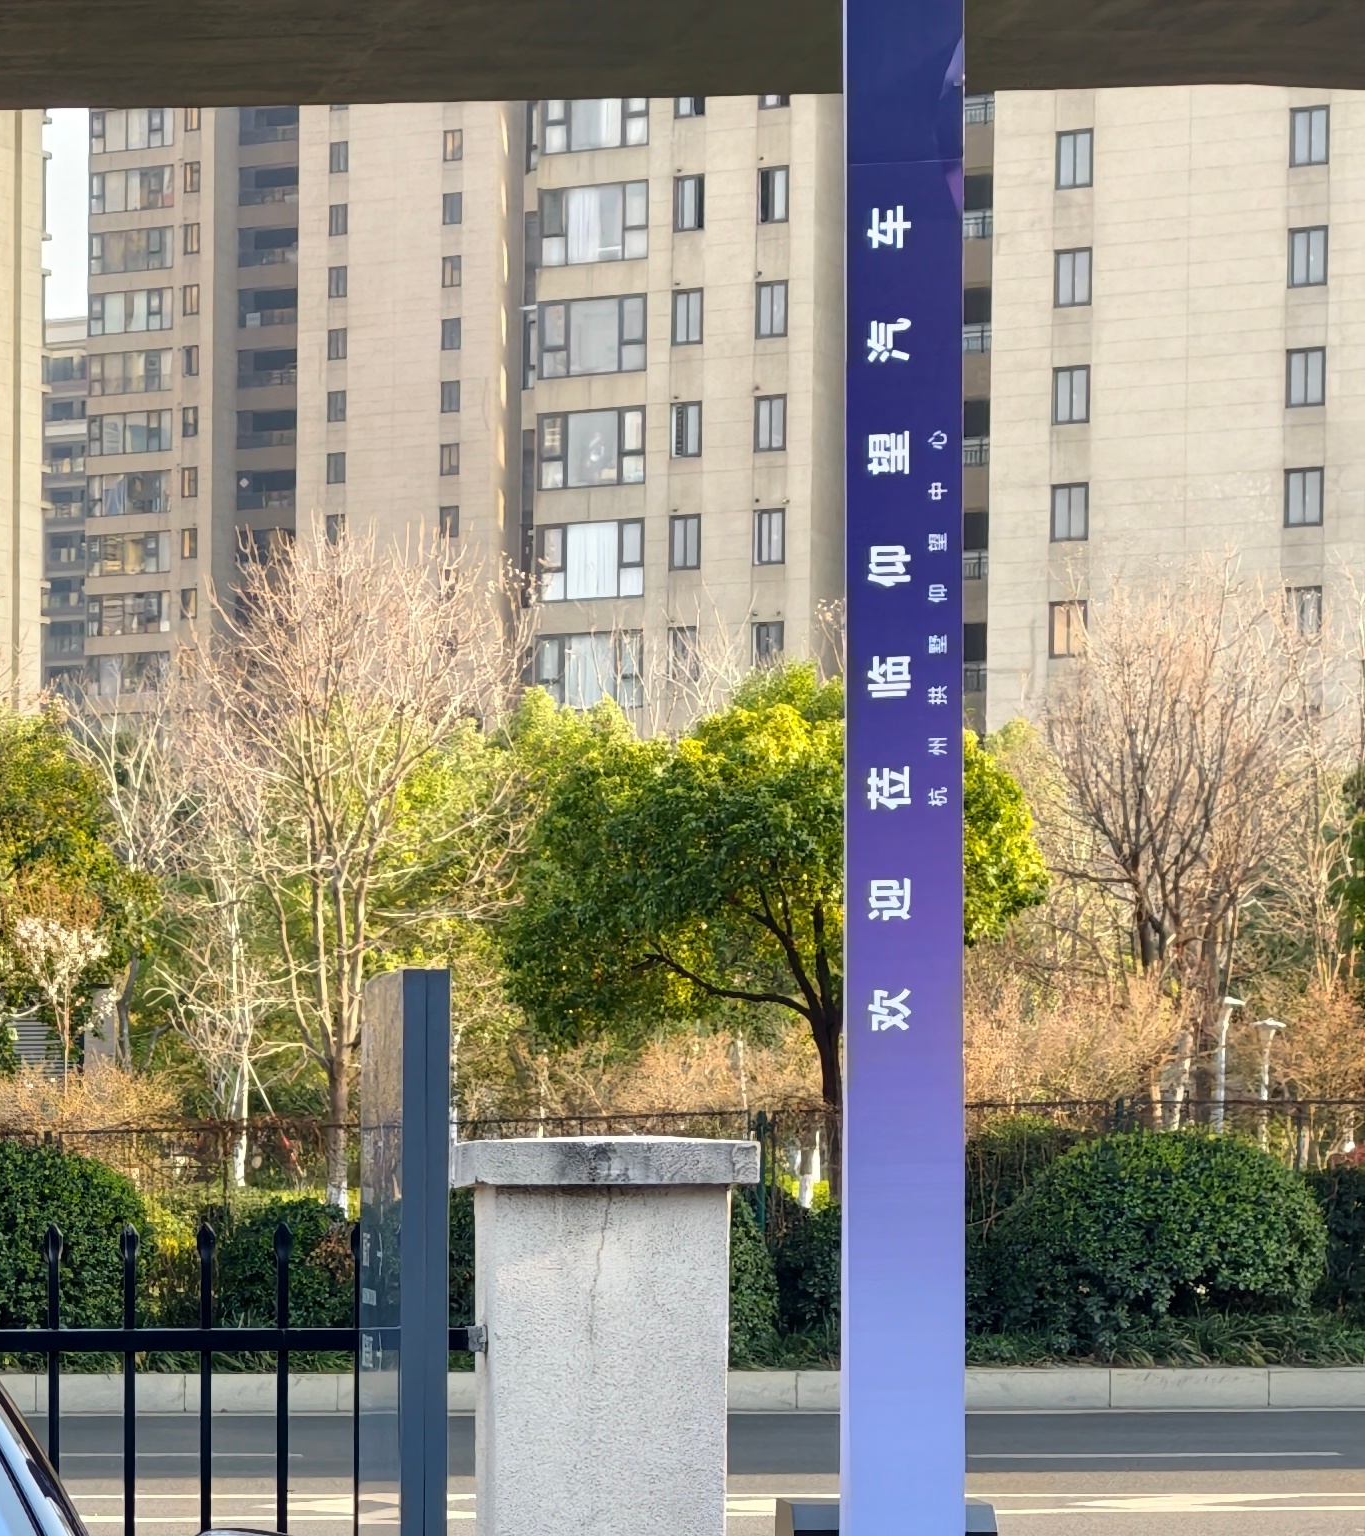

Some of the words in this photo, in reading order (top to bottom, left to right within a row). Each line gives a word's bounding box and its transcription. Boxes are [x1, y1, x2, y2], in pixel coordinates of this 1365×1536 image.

[867, 205, 912, 1032] 欢迎莅临仰望汽车
[928, 430, 948, 806] 杭州拱墅仰望中心
